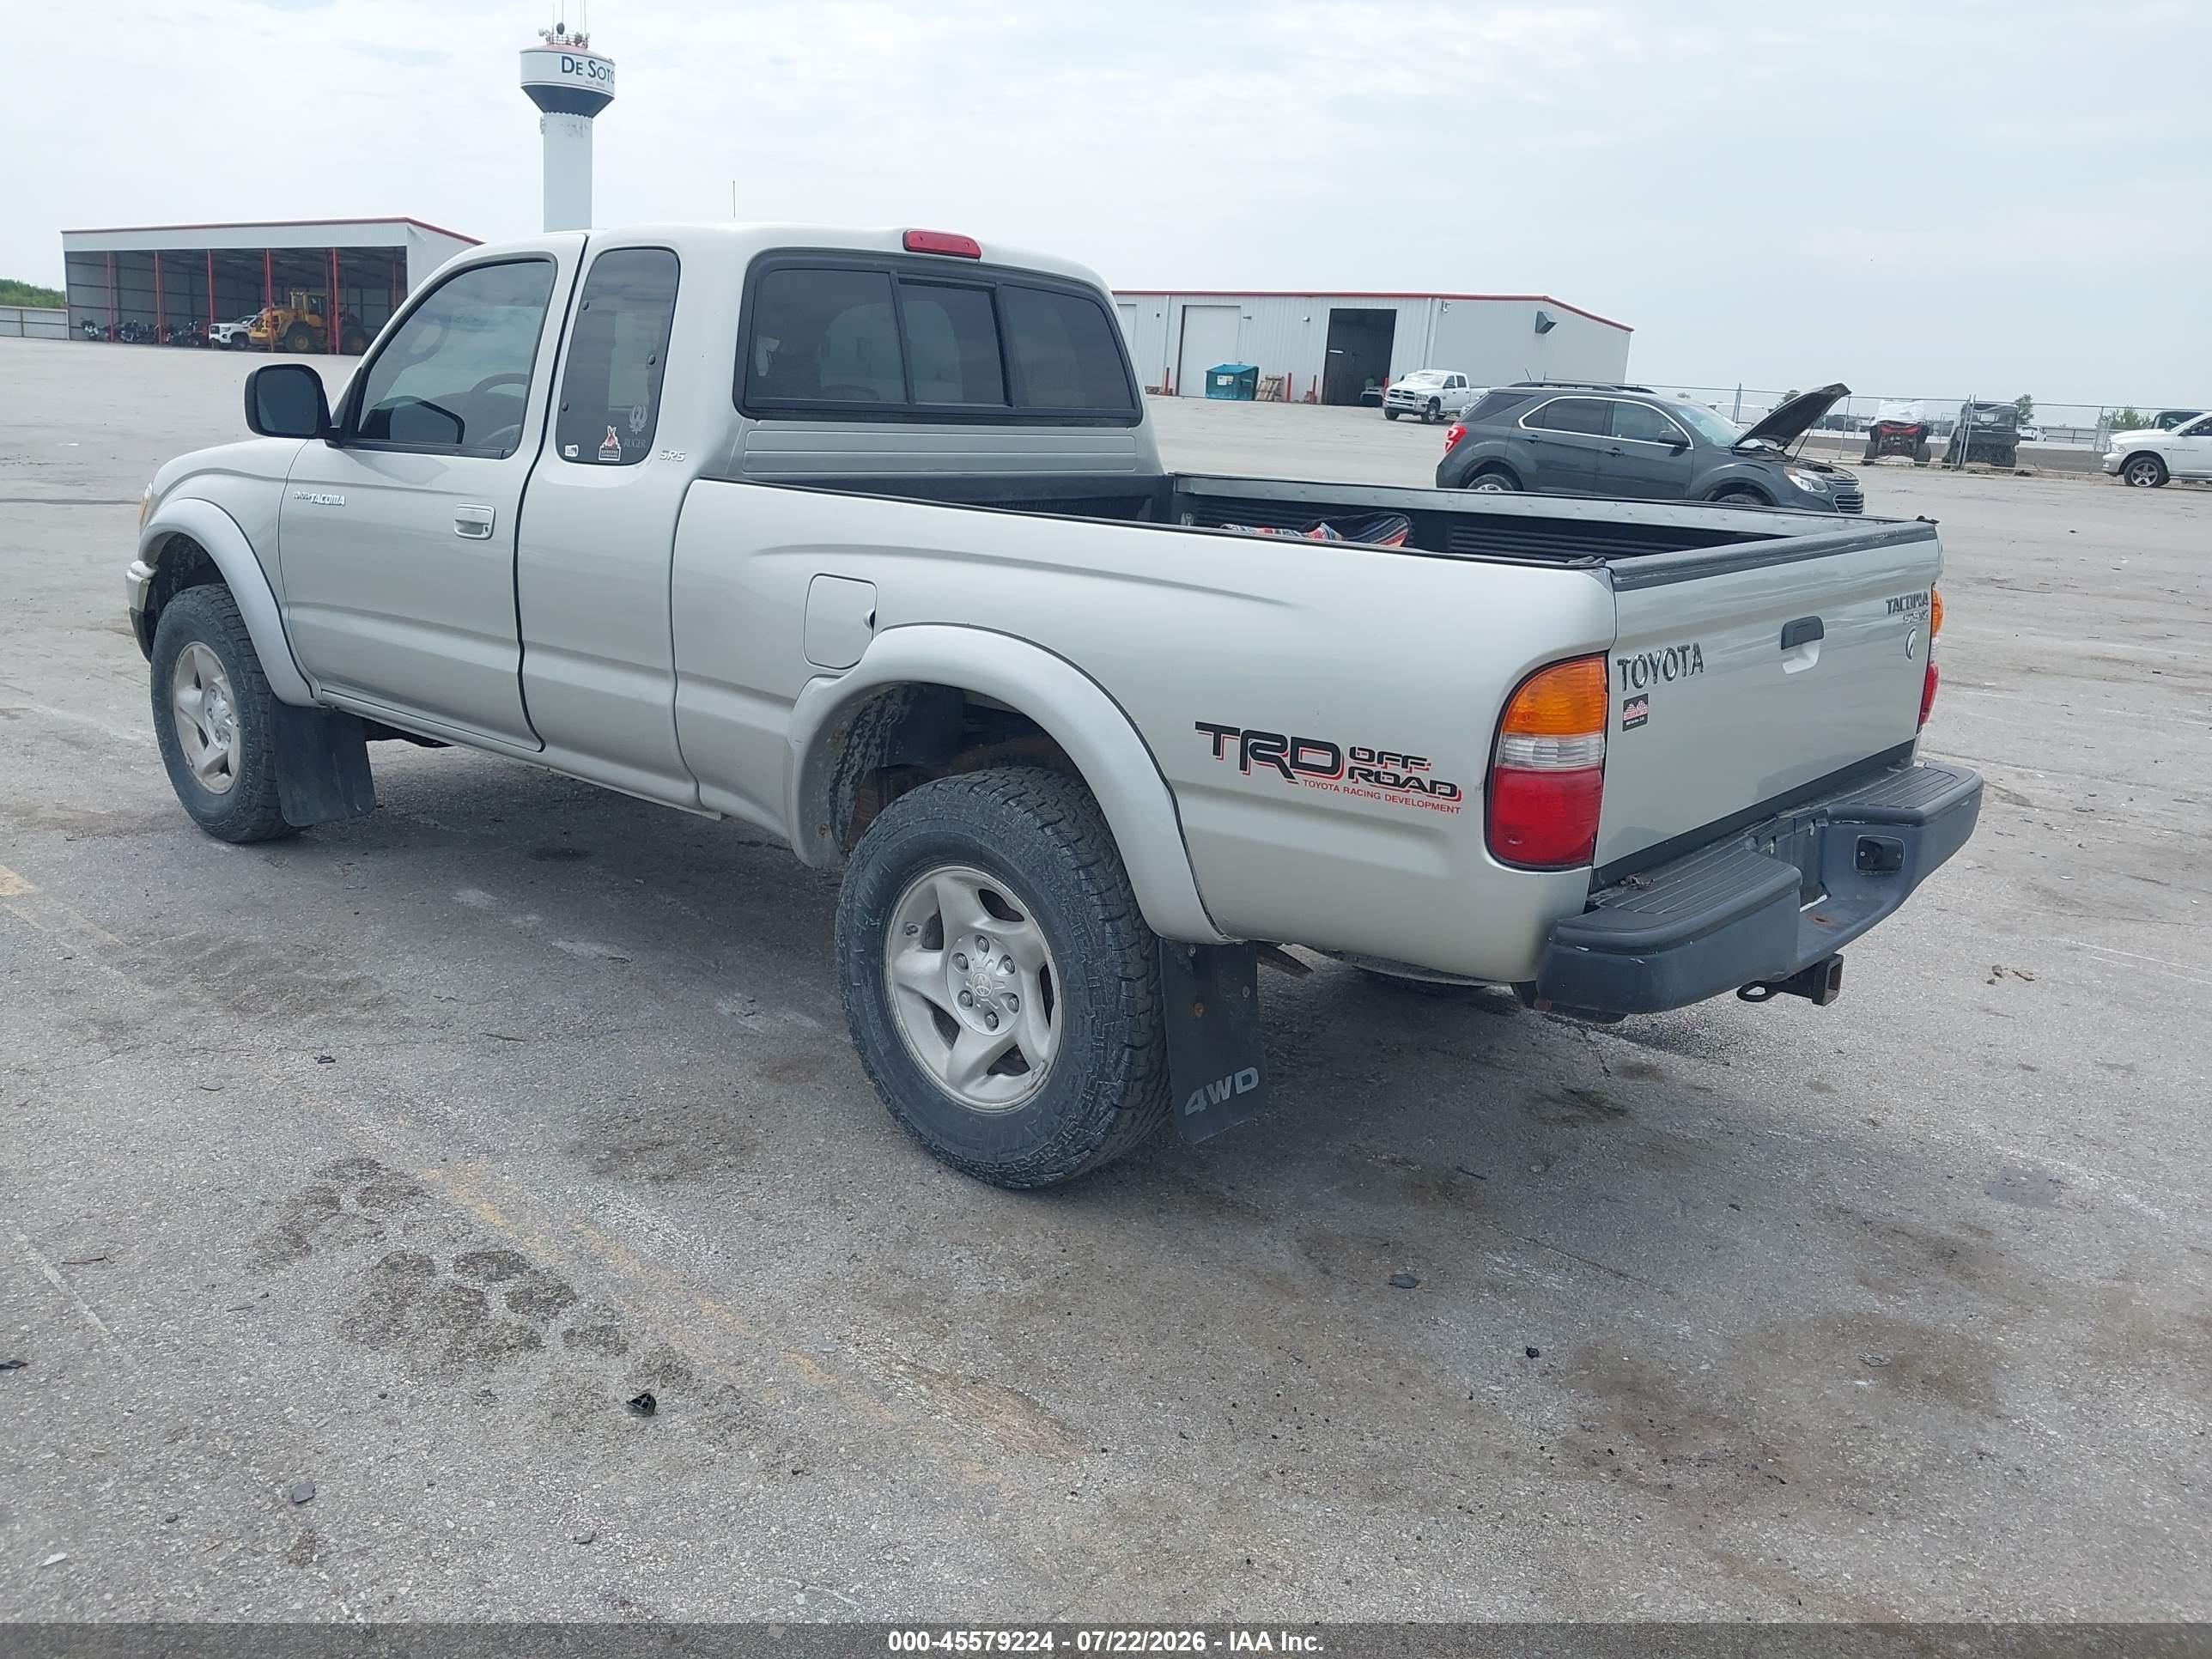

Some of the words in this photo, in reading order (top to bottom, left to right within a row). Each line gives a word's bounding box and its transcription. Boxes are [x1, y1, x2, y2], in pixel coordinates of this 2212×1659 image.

[659, 450, 686, 462] SR5
[310, 493, 345, 506] TACOMA
[1886, 591, 1929, 615] TACOMA
[1617, 642, 1704, 691] TOYOTA
[1194, 720, 1345, 783] TRD
[1348, 745, 1431, 773] OFF
[1303, 779, 1340, 793] TOYOTA
[1343, 786, 1382, 800] RACING
[1384, 793, 1462, 815] DEVELOPMENT
[1347, 766, 1462, 802] ROAD
[1185, 1066, 1259, 1115] 4WD
